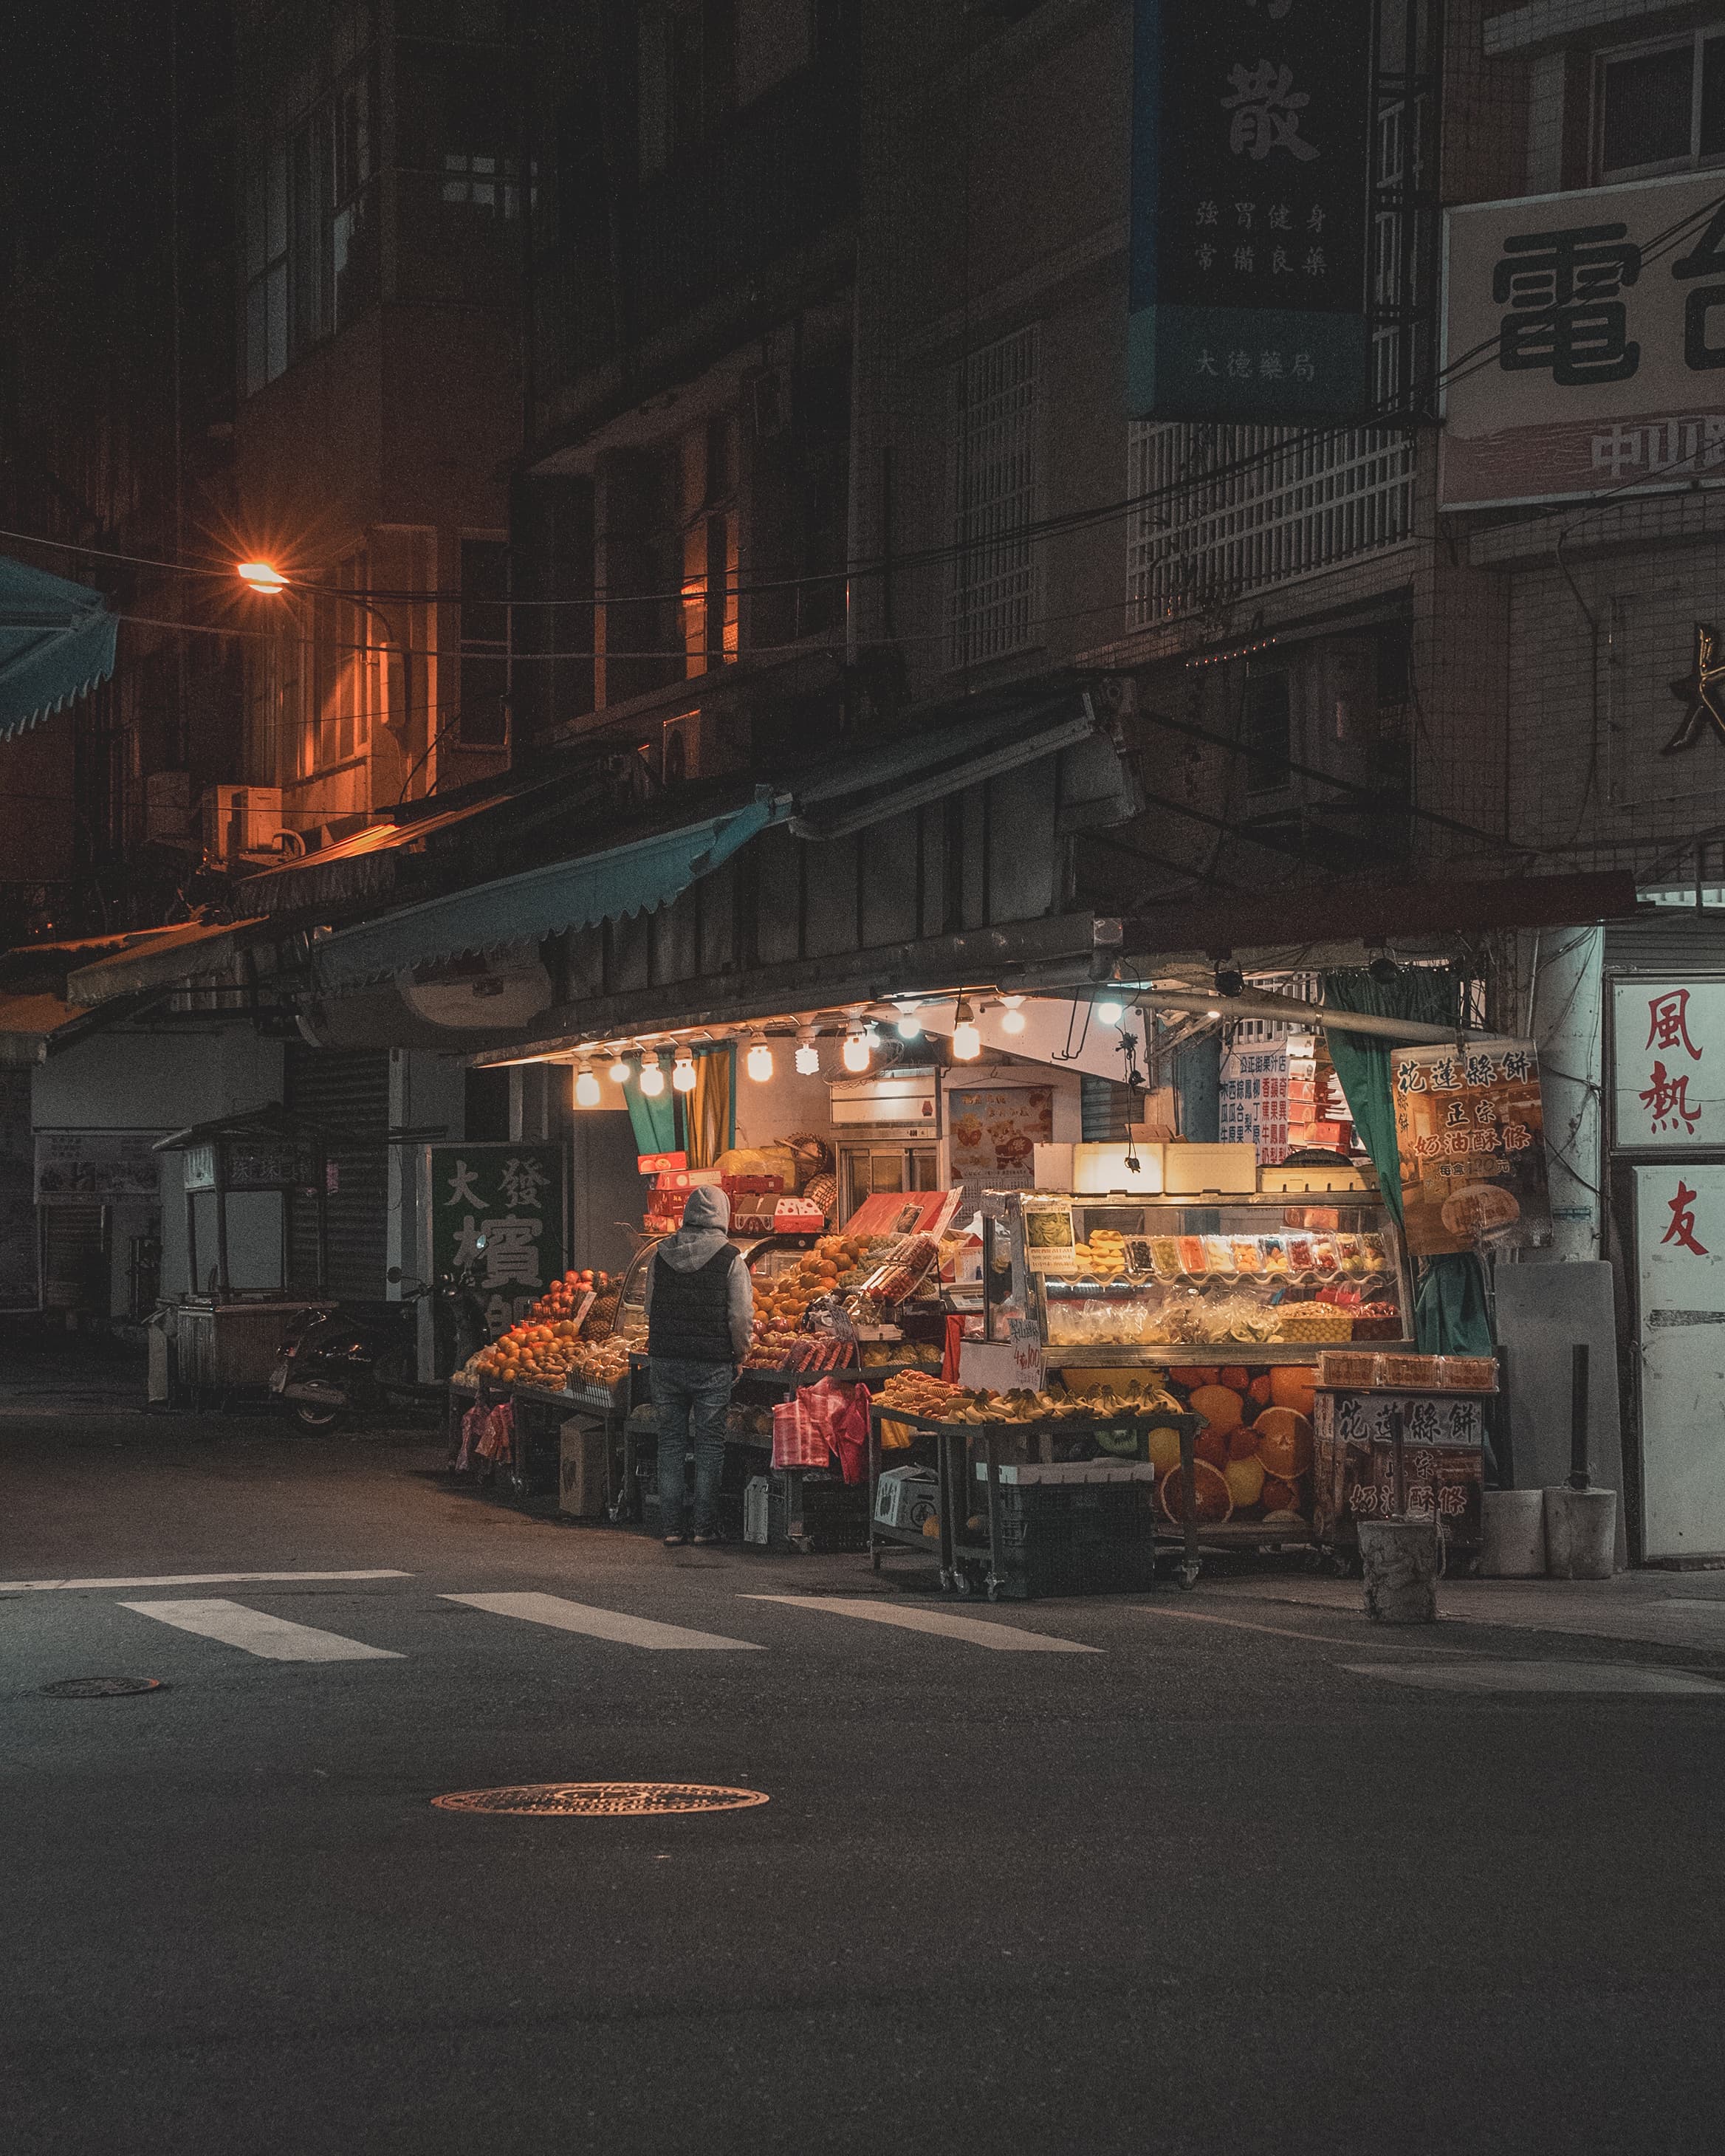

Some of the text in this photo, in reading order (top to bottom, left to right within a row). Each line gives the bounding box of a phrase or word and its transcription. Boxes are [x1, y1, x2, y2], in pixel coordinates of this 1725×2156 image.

[1196, 200, 1326, 234] 強胃健身
[1196, 349, 1315, 382] 大德藥局
[1241, 1056, 1286, 1074] 公正街果汁店
[1398, 1050, 1532, 1095] 花蓮縣餅
[1446, 1100, 1497, 1127] 正宗
[1415, 1125, 1532, 1157] 奶油酥條
[443, 1157, 551, 1209] 大發
[1661, 1181, 1709, 1257] 友
[1340, 1400, 1477, 1444] 花蓮縣餅
